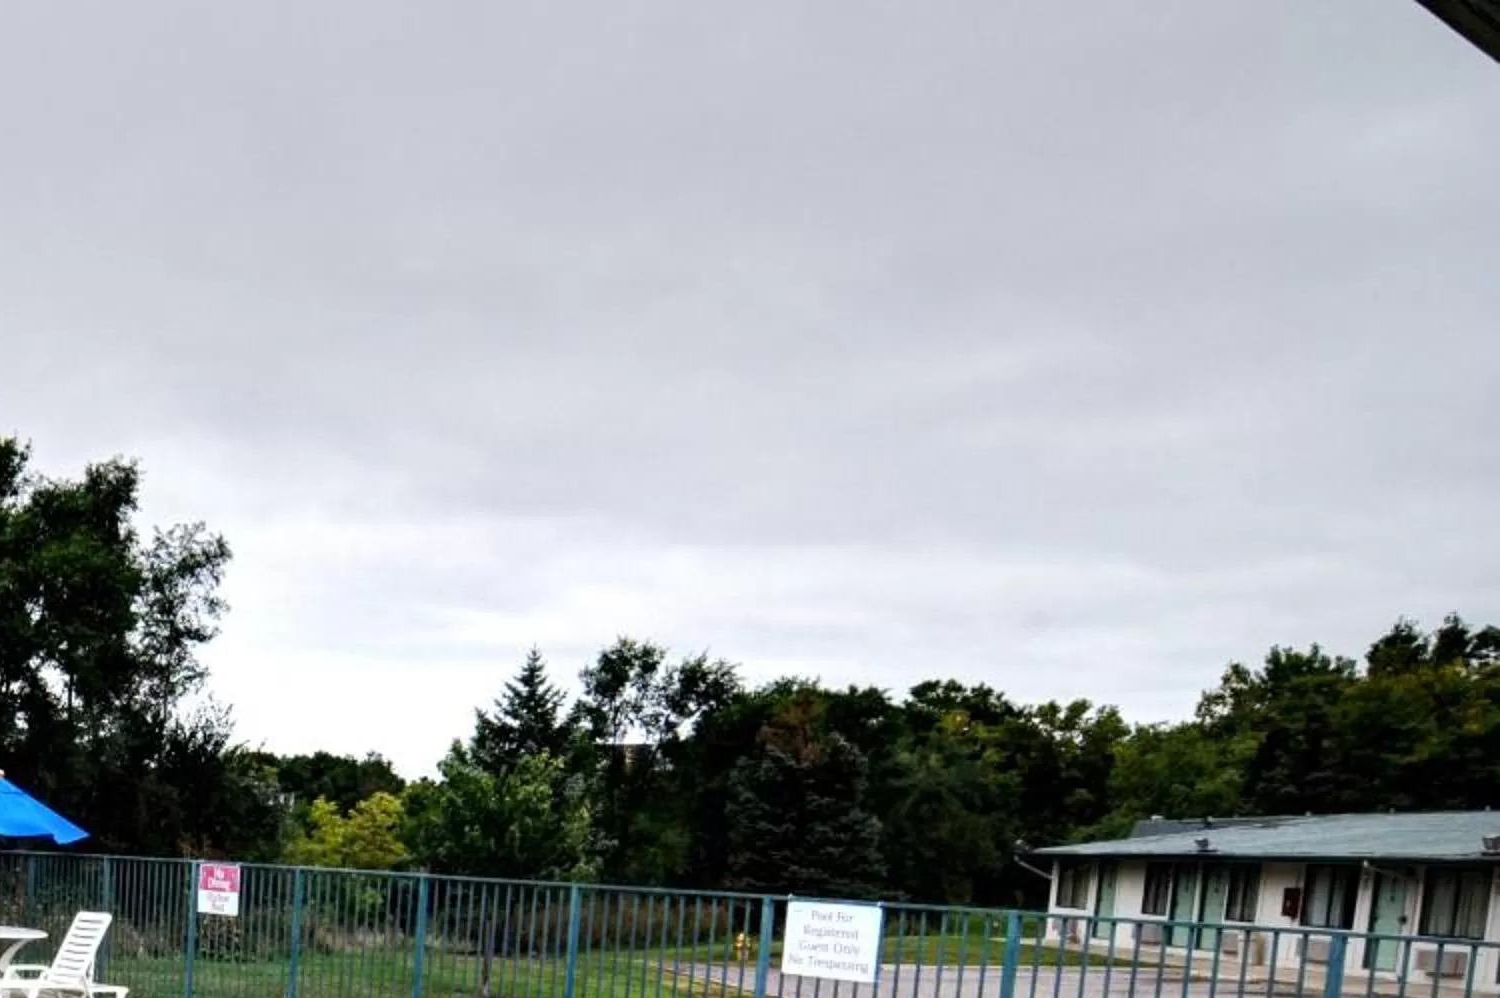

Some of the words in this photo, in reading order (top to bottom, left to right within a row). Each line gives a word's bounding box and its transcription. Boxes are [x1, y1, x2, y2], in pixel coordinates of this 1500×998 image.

[811, 908, 833, 922] Pool
[836, 911, 854, 923] For
[803, 924, 859, 941] Registered
[833, 943, 861, 956] Only
[808, 955, 868, 974] Trespassing
